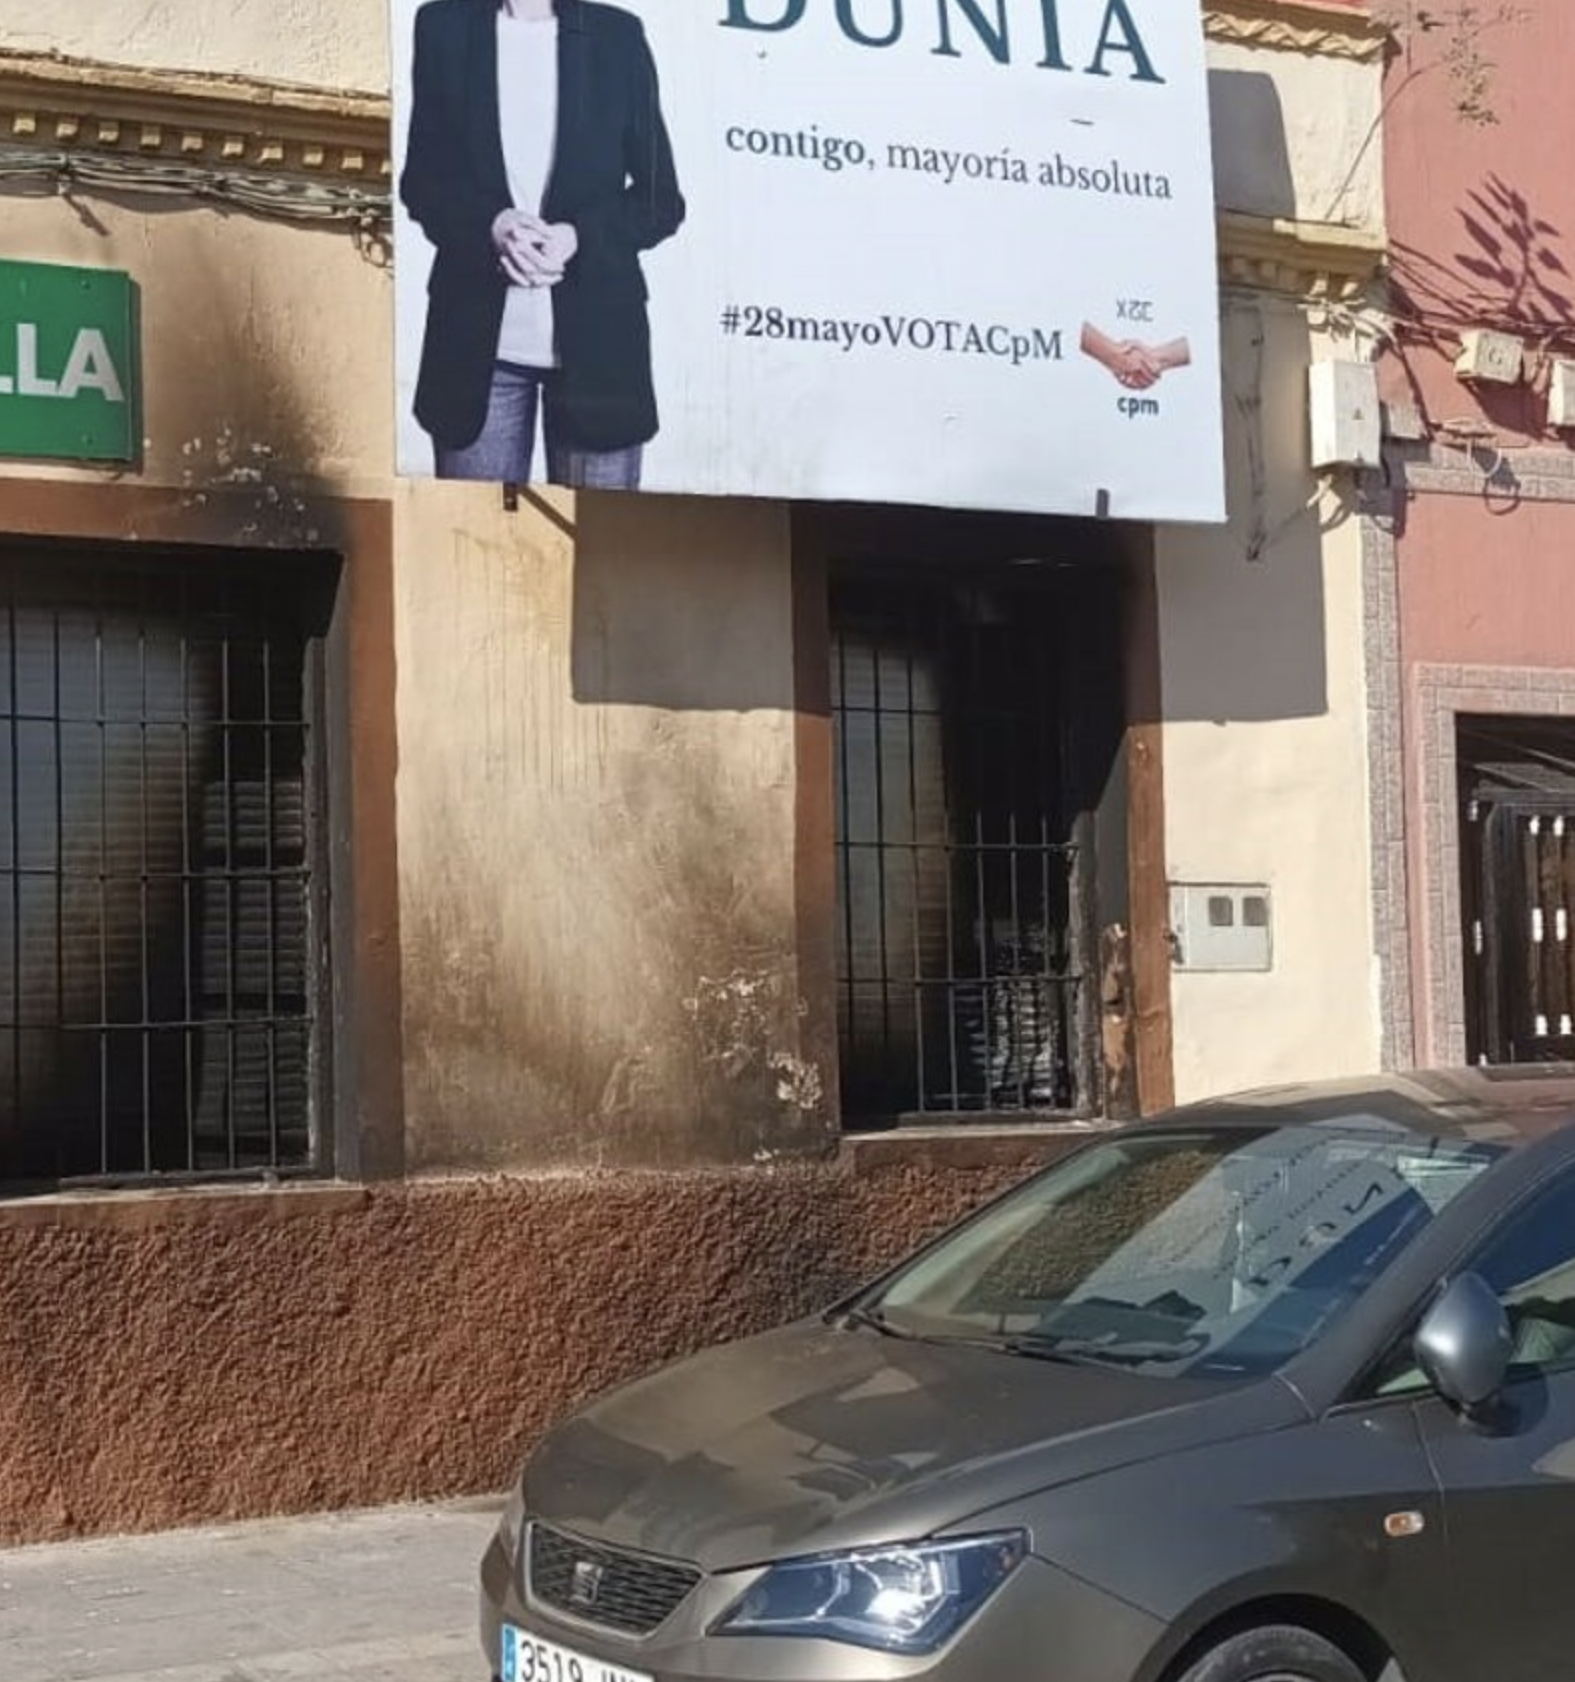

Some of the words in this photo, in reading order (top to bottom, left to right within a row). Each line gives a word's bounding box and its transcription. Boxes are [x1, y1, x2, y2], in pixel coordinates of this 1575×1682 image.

[726, 125, 875, 171] contigo,
[886, 145, 1029, 184] mayoría
[1038, 153, 1172, 199] absoluta
[720, 306, 1063, 366] #28mayoVOTACpM
[1116, 396, 1160, 419] cpm
[521, 1640, 583, 1682] 3519
